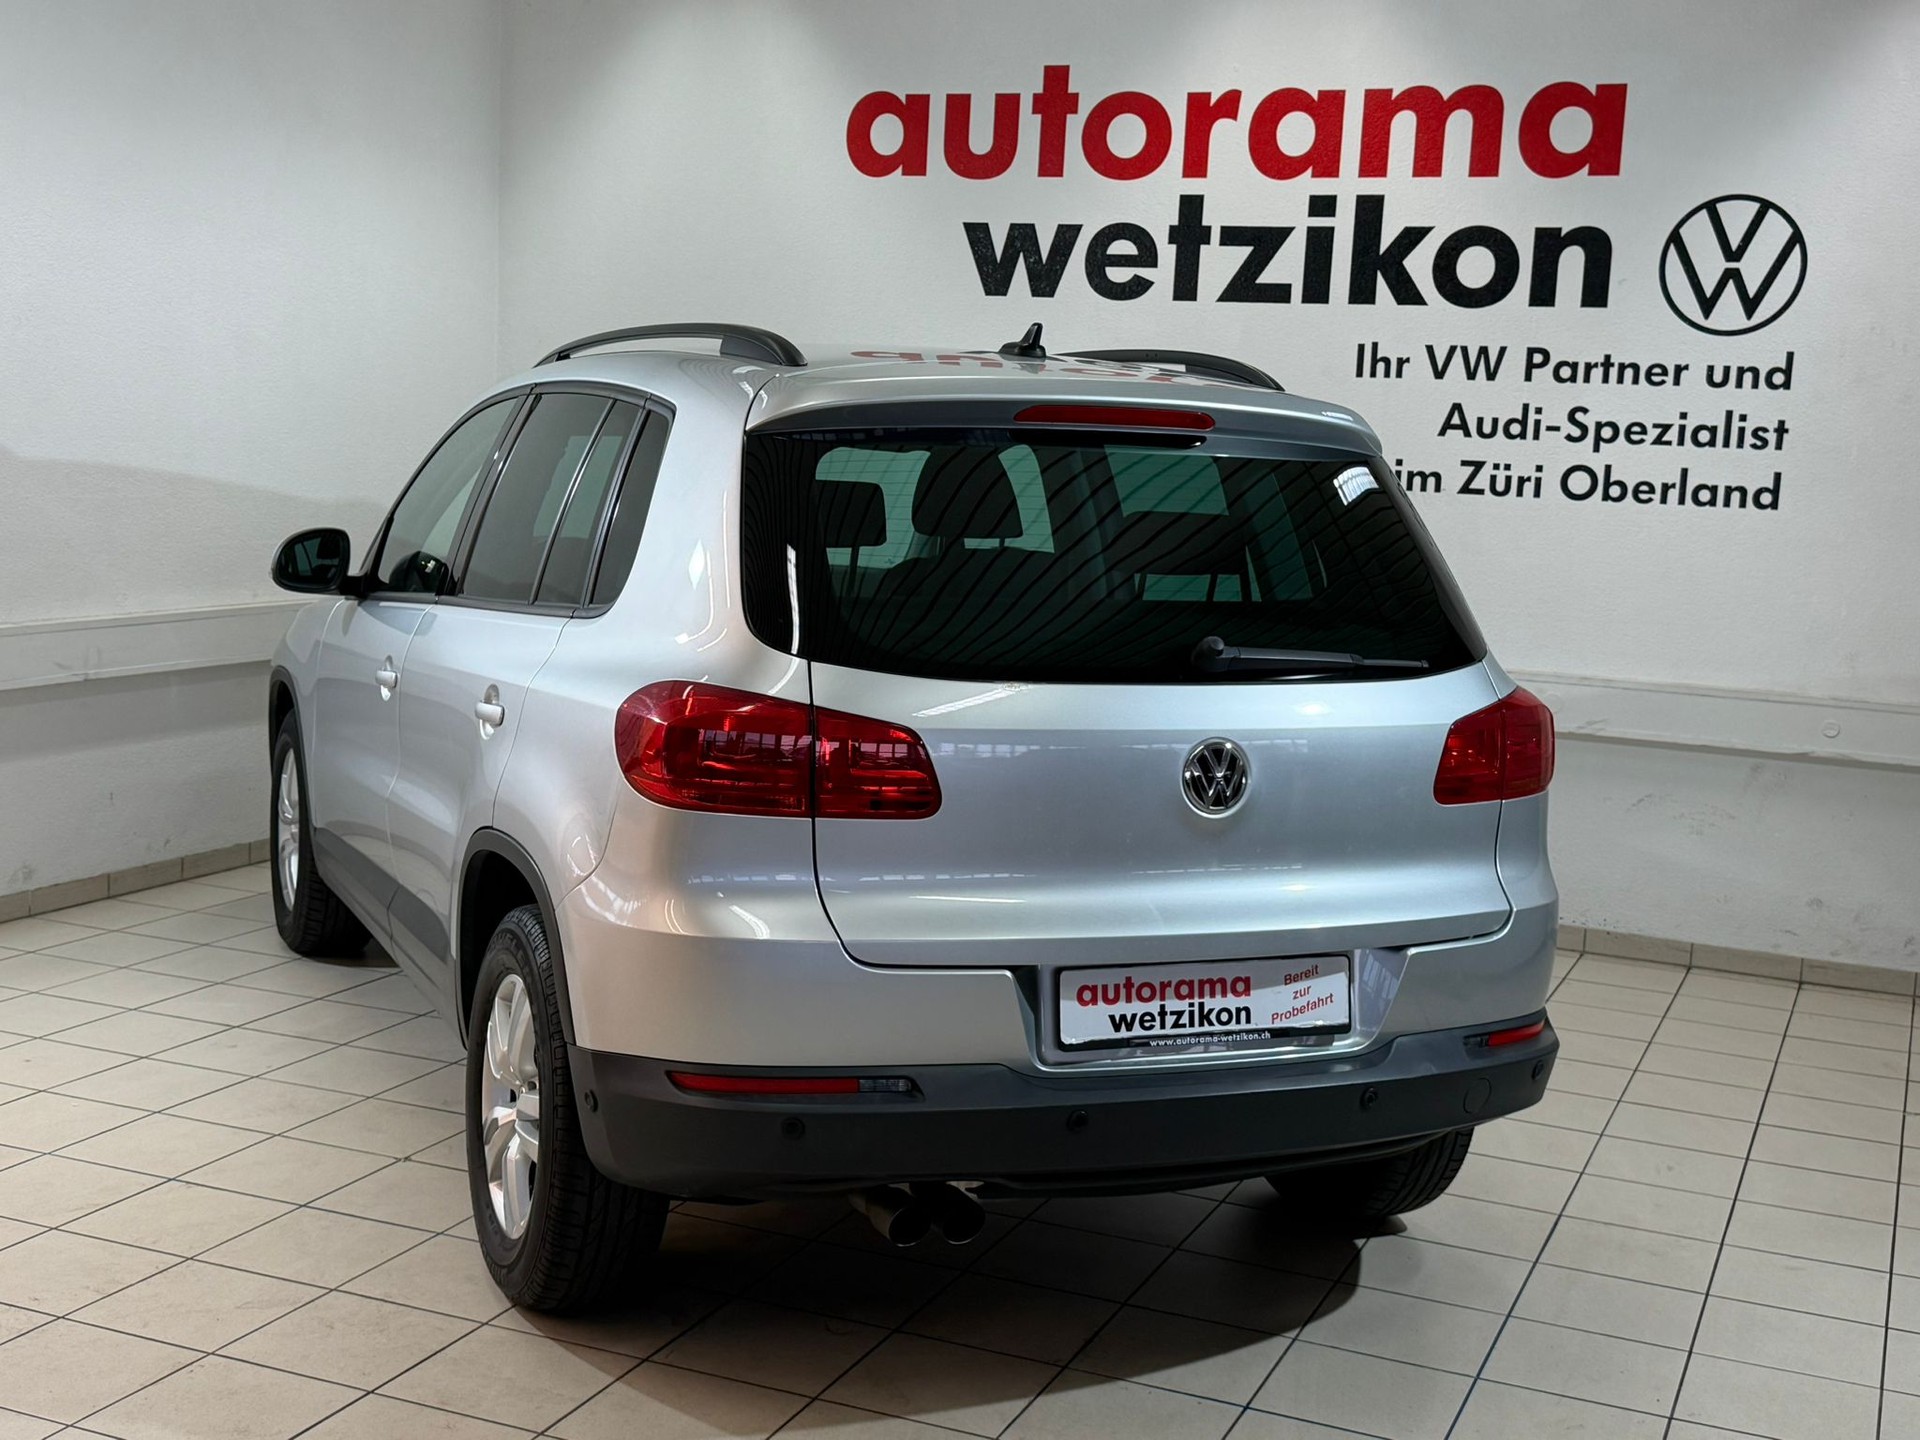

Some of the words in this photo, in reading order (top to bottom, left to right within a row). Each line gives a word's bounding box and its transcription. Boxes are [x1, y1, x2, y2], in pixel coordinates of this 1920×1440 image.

[847, 66, 1627, 181] autorama
[962, 194, 1613, 309] wetzikon
[1355, 341, 1411, 379] Ihr
[1424, 344, 1508, 382] VW
[1523, 346, 1690, 387] Partner
[1705, 351, 1795, 391] und
[1437, 402, 1790, 454] Audi-Spezialist
[1395, 458, 1442, 493] im
[1456, 459, 1544, 499] Züri
[1559, 464, 1782, 511] Oberland
[1076, 975, 1252, 1007] autorama
[1284, 964, 1320, 986] Bereit
[1271, 992, 1335, 1026] Probefahrt
[1292, 984, 1312, 1001] zur
[1108, 1002, 1251, 1033] wetzikon
[1149, 1030, 1271, 1047] www.autorama-wetzikon.ch
